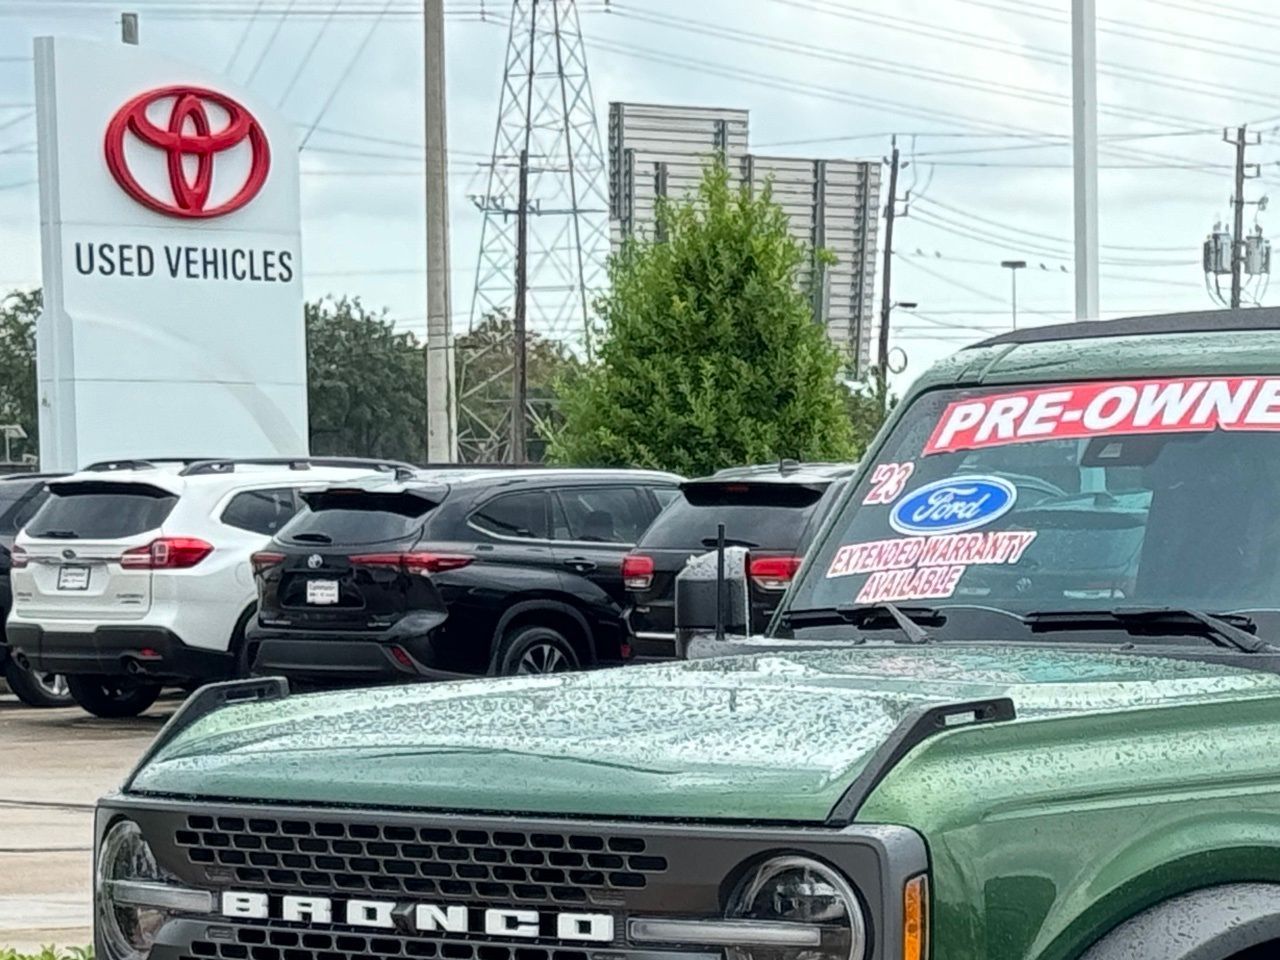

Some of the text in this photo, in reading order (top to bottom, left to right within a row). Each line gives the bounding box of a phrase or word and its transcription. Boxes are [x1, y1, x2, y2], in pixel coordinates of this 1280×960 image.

[75, 242, 293, 283] USED VEHICLES
[911, 486, 992, 522] Ford
[829, 532, 1034, 576] EXTENDED WARRANTY
[857, 567, 962, 603] AVAILABLE
[222, 891, 614, 942] BRONCO
